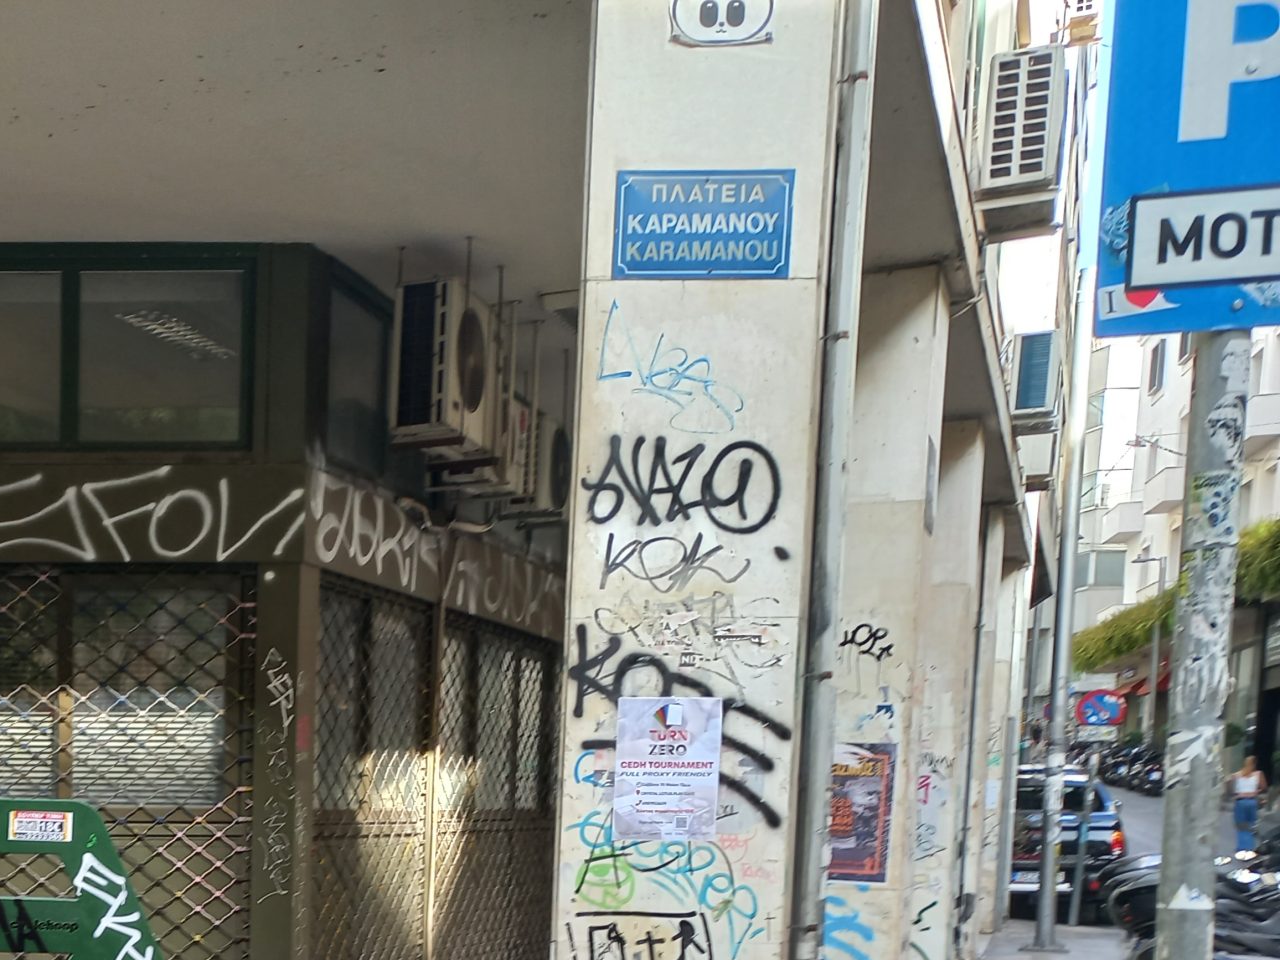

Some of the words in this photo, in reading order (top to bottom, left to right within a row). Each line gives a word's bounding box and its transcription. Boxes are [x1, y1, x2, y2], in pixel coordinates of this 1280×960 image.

[1177, 0, 1280, 143] P
[651, 183, 766, 204] ΠΛΑΤΕΙΑ
[626, 211, 780, 235] ΚΑΡΑΜΑΝΟΥ
[625, 239, 779, 263] KARAMANOU
[649, 730, 689, 741] TURN
[648, 744, 688, 756] ZERO
[620, 761, 647, 769] CEDH
[648, 761, 715, 769] TOURNAMENT
